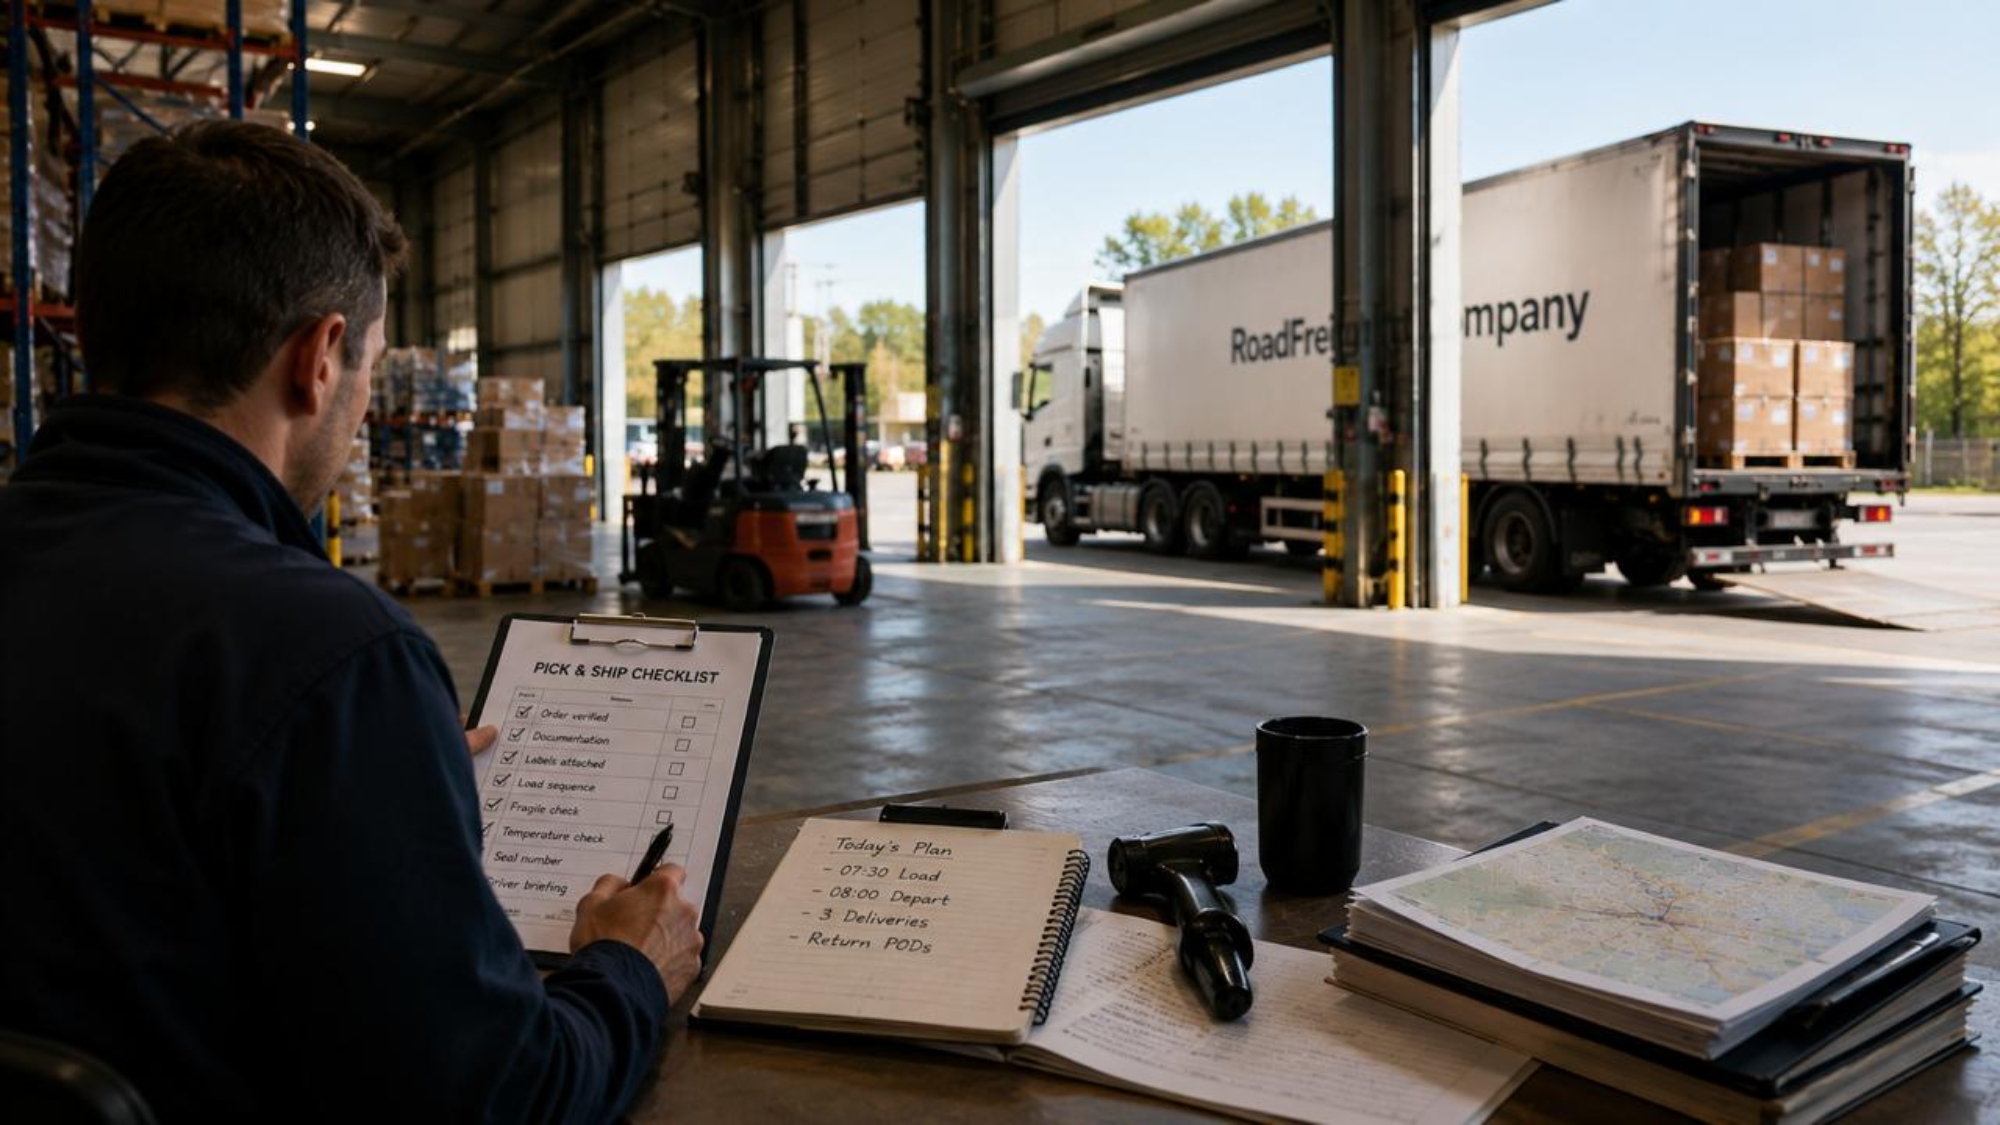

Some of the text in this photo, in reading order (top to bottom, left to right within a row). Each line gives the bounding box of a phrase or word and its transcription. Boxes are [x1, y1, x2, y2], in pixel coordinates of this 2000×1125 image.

[1463, 290, 1590, 348] mpany
[533, 661, 720, 684] PICK & SHIP CHECKLIST
[540, 708, 609, 723] Order verified
[524, 755, 606, 769] Labels attached
[517, 778, 596, 793] Load sequence
[510, 801, 579, 816] Fragile check
[502, 826, 605, 843] Temperature check
[837, 837, 952, 857] Today's Plan
[493, 851, 563, 865] Seal number
[840, 865, 889, 878] 07:30
[899, 867, 942, 882] Load
[524, 880, 568, 896] briefing
[829, 886, 879, 899] 08:00
[890, 890, 950, 907] Depart
[818, 908, 833, 921] 3
[843, 909, 929, 928] Deliveries
[808, 931, 871, 949] Return
[883, 936, 933, 954] PODs
